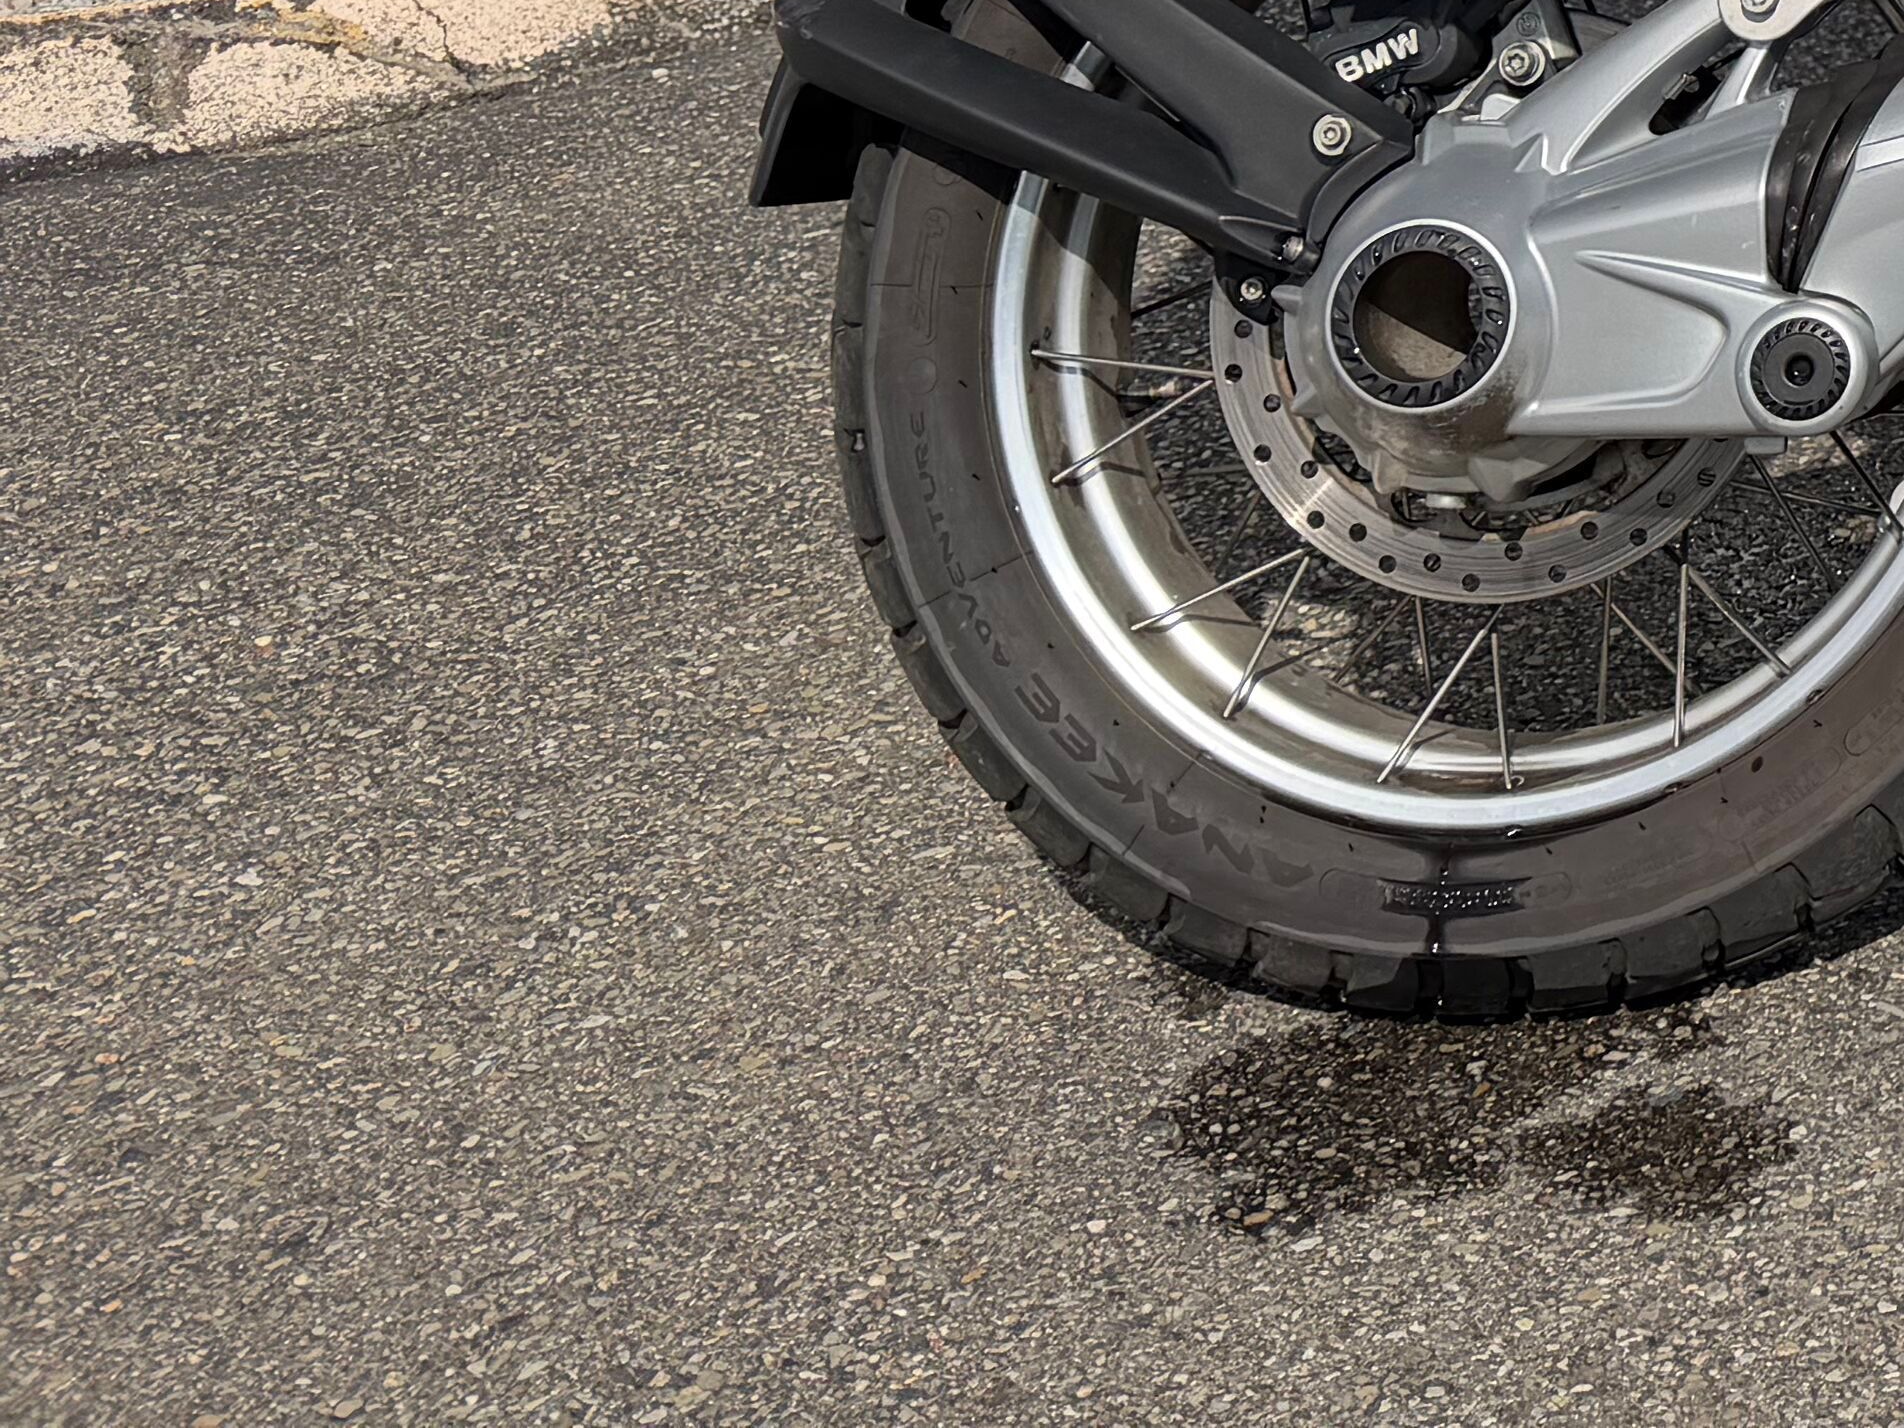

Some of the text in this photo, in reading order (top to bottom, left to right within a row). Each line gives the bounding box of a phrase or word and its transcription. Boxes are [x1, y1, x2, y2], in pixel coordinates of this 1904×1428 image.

[1335, 27, 1421, 83] BMW
[908, 410, 1314, 890] ANAKEE ADVENTURE
